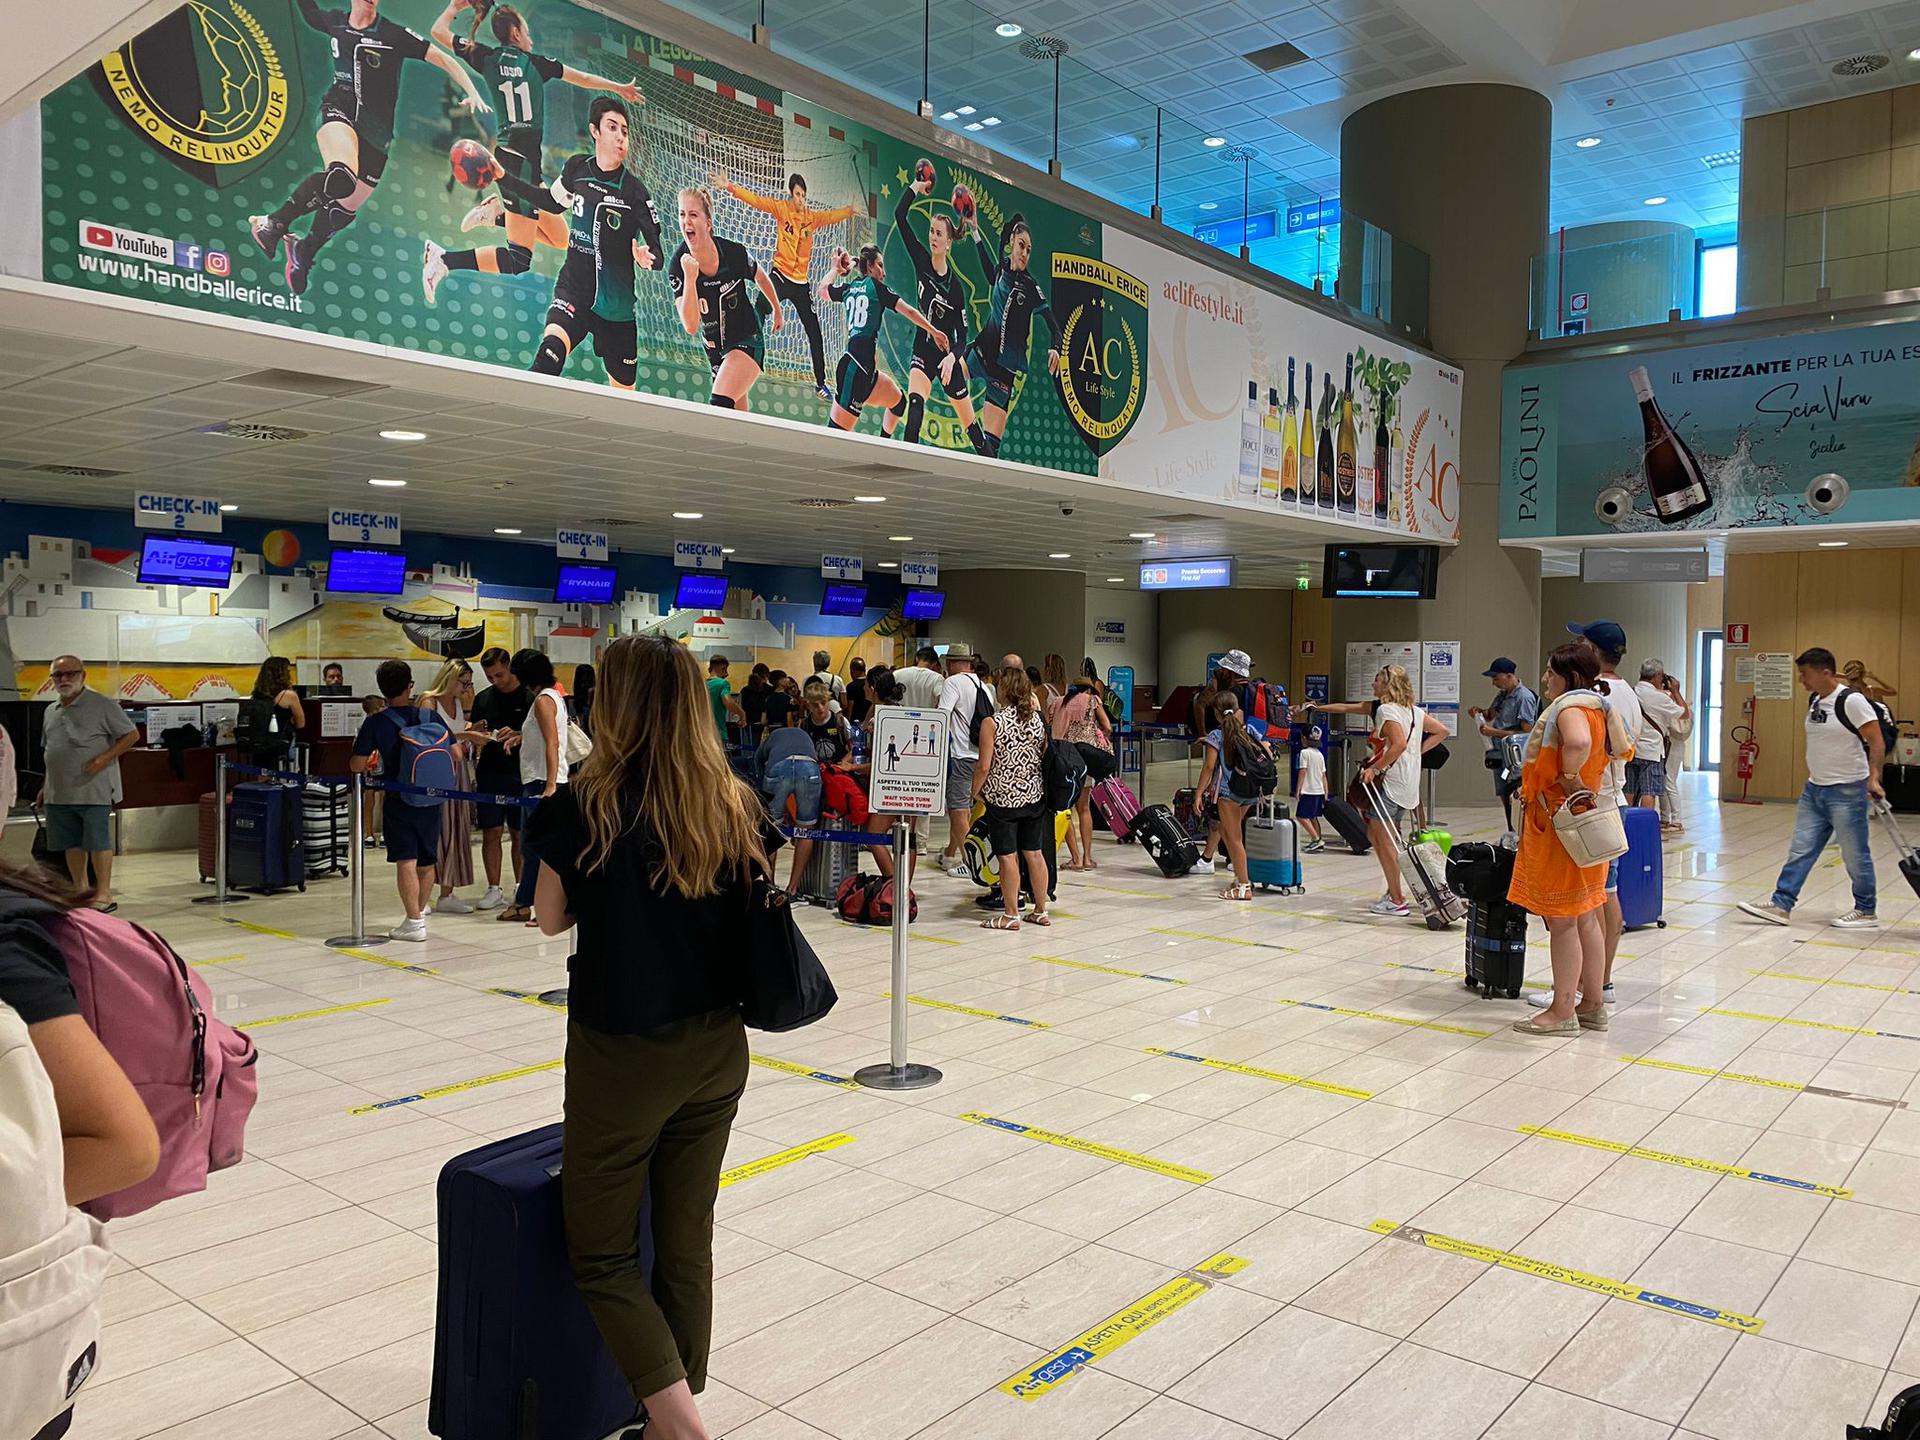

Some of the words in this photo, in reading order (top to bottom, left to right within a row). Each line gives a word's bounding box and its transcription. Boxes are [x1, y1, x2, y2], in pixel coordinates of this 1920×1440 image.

[498, 80, 533, 123] 11
[110, 70, 160, 132] NEMO
[169, 91, 284, 160] RELINQUATUR
[784, 221, 794, 236] 24
[115, 232, 167, 259] YouTube
[78, 253, 302, 312] www.handballerice.it
[1054, 259, 1114, 287] HANDBALL
[1116, 274, 1147, 303] ERICE
[1163, 280, 1244, 326] aclifestyle.it
[1078, 331, 1123, 380] AC
[1673, 373, 1684, 384] IL
[1693, 360, 1791, 383] FRIZZANTE
[1797, 356, 1827, 371] PER
[1834, 352, 1854, 367] LA
[1860, 350, 1896, 365] TUA
[1085, 380, 1099, 394] Life
[1100, 381, 1116, 399] Style
[1061, 367, 1079, 416] NEMO
[1081, 384, 1138, 436] RELINQUATUR
[1518, 384, 1545, 523] PAOLINI
[1413, 443, 1460, 522] AC
[138, 495, 219, 516] CHECK-IN
[174, 515, 185, 529] 2
[331, 511, 398, 530] CHECK-IN
[361, 529, 370, 541] 3
[559, 531, 606, 548] CHECK-IN
[144, 550, 211, 568] Airgest
[580, 547, 587, 558] 4
[676, 543, 721, 557] CHECK-IN
[696, 556, 702, 567] 5
[823, 556, 861, 569] CHECK-IN
[903, 563, 937, 576] CHECK-IN
[840, 568, 846, 578] 6
[917, 575, 922, 584] 7
[1181, 568, 1199, 576] Pronto
[568, 579, 611, 588] RYANAIR
[687, 587, 723, 595] RYANAIR
[912, 600, 942, 608] RYANAIR
[877, 779, 901, 787] ASPETTA
[1533, 1266, 1565, 1280] QUI
[1569, 1275, 1634, 1298] ASPETTA
[1671, 1302, 1758, 1328] Airgest
[1012, 1356, 1072, 1397] Airgest
[1083, 1324, 1127, 1349] ASPETTA
[1121, 1310, 1146, 1330] QUI
